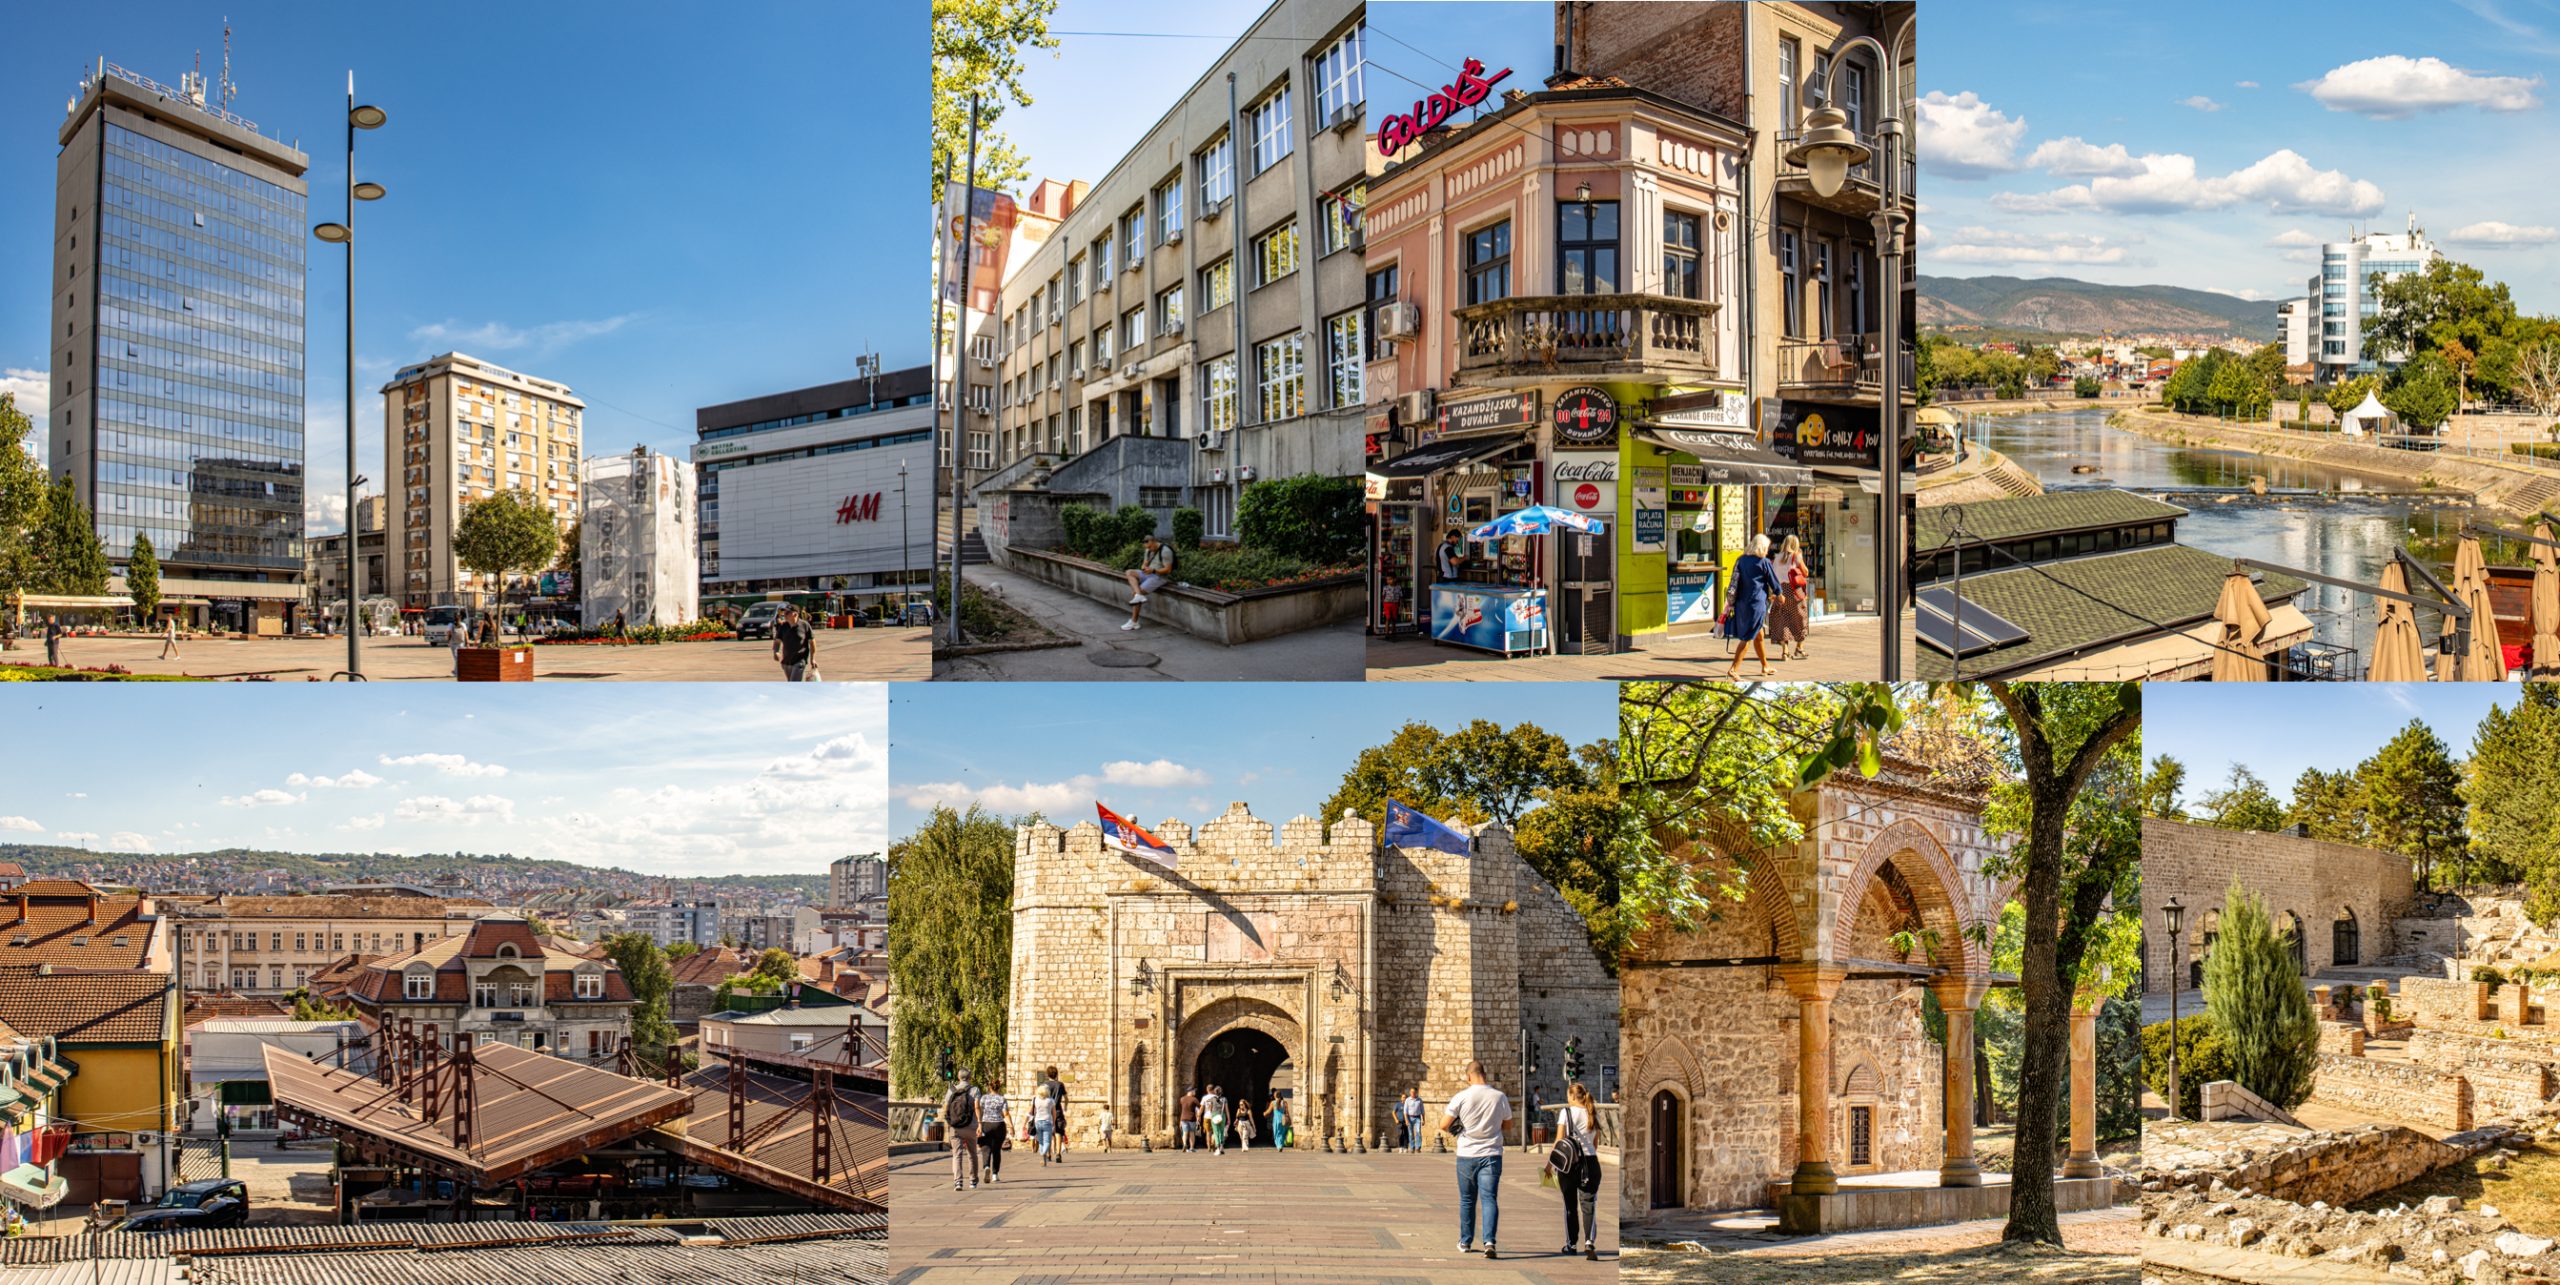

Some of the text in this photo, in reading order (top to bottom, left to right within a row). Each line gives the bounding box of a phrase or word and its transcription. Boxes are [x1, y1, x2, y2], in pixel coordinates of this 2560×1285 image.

[1452, 397, 1517, 417] KAZANDŽIJSKO
[1461, 411, 1499, 428] DUVANČE
[1556, 409, 1571, 423] 00
[1597, 409, 1611, 423] 24
[1702, 412, 1725, 422] OFFICE
[1669, 430, 1757, 451] Coca-Cola
[1823, 429, 1880, 450] IS ONLY 4 YOU
[1553, 460, 1617, 480] Coca-Cola
[1575, 492, 1598, 501] Coca-Cola
[836, 491, 882, 525] H&M
[1446, 516, 1464, 526] IQOS
[1638, 511, 1663, 520] UPLATA
[1638, 519, 1663, 529] RAČUNA
[1669, 576, 1685, 586] PLATI
